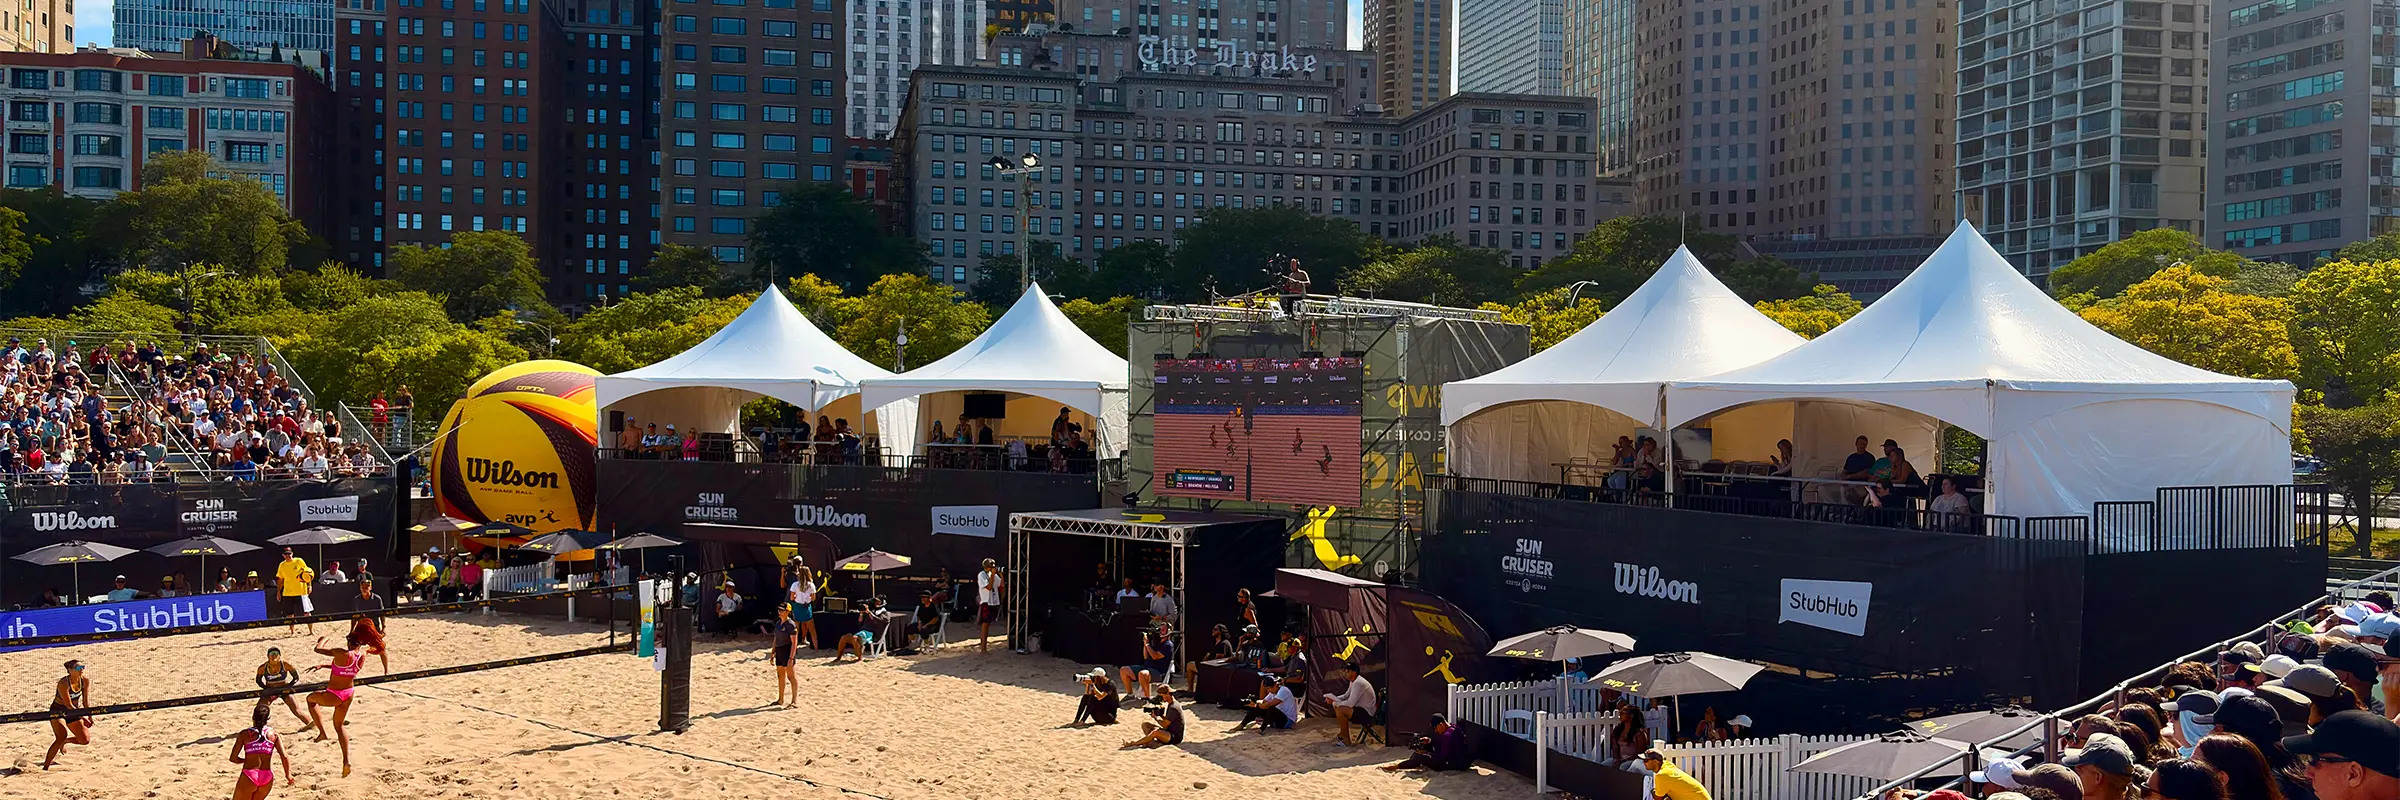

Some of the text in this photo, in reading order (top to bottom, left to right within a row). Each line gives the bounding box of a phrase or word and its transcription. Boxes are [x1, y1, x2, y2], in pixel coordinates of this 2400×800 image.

[1138, 36, 1318, 72] The Drake
[466, 457, 559, 489] Wilson
[196, 499, 224, 510] SUN
[699, 493, 724, 504] SUN
[181, 510, 238, 522] CRUISER
[307, 505, 352, 515] StubHub
[684, 506, 738, 519] CRUISER
[793, 504, 868, 528] Wilson
[32, 510, 117, 532] Wilson
[505, 513, 537, 527] avp
[939, 514, 990, 527] StubHub
[1516, 538, 1542, 555] SUN
[1502, 555, 1554, 576] CRUISER
[1613, 561, 1699, 604] Wilson
[1789, 591, 1858, 618] StubHub
[94, 600, 234, 633] StubHub
